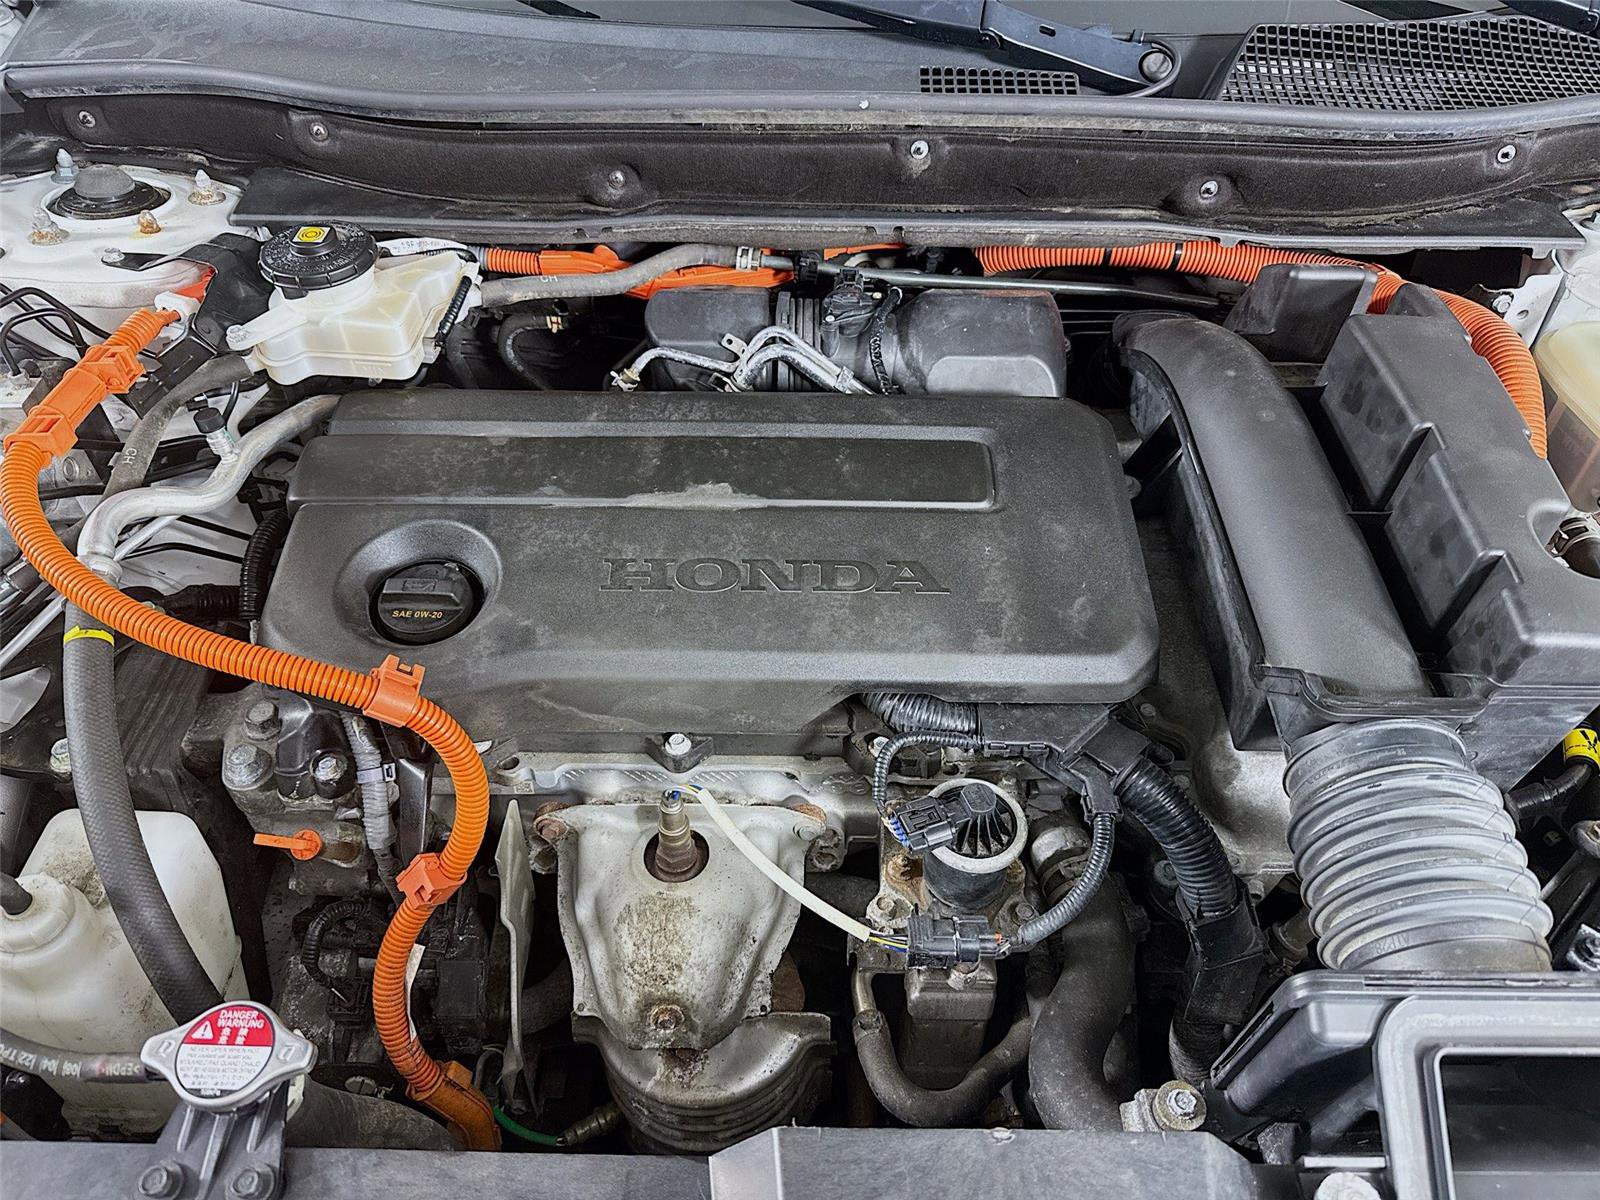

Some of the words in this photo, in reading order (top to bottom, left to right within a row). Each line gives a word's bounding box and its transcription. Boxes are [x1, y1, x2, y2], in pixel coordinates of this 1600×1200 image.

[599, 557, 951, 595] HONDA
[392, 610, 412, 618] SAE
[414, 610, 443, 619] 0W-20
[219, 1009, 259, 1019] DANGER
[217, 1018, 264, 1029] WARNUNG
